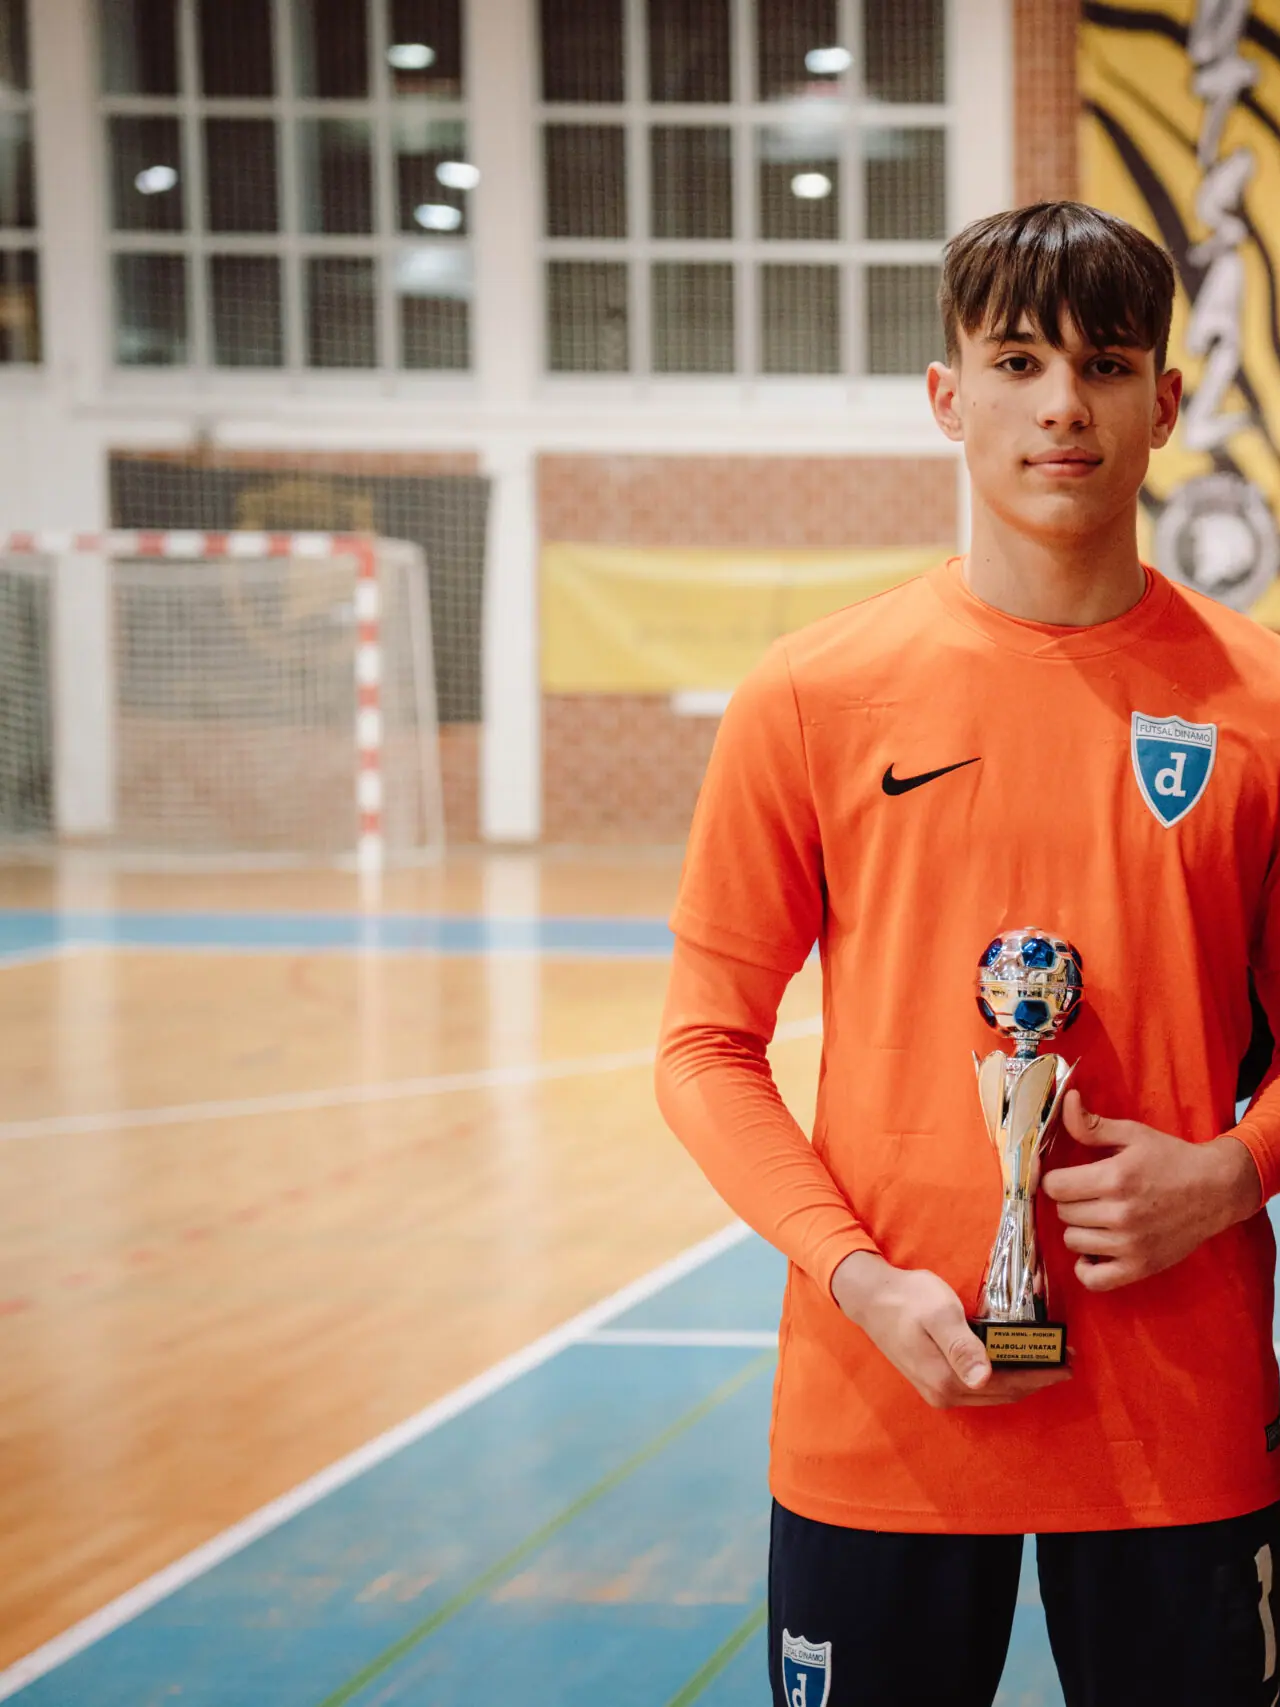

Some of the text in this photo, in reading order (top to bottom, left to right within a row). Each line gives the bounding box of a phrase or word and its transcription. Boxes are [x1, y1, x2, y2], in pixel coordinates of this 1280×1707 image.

[1140, 724, 1211, 743] FUTSAL DINAMO
[1154, 752, 1187, 798] d
[799, 1650, 824, 1663] DINAMO
